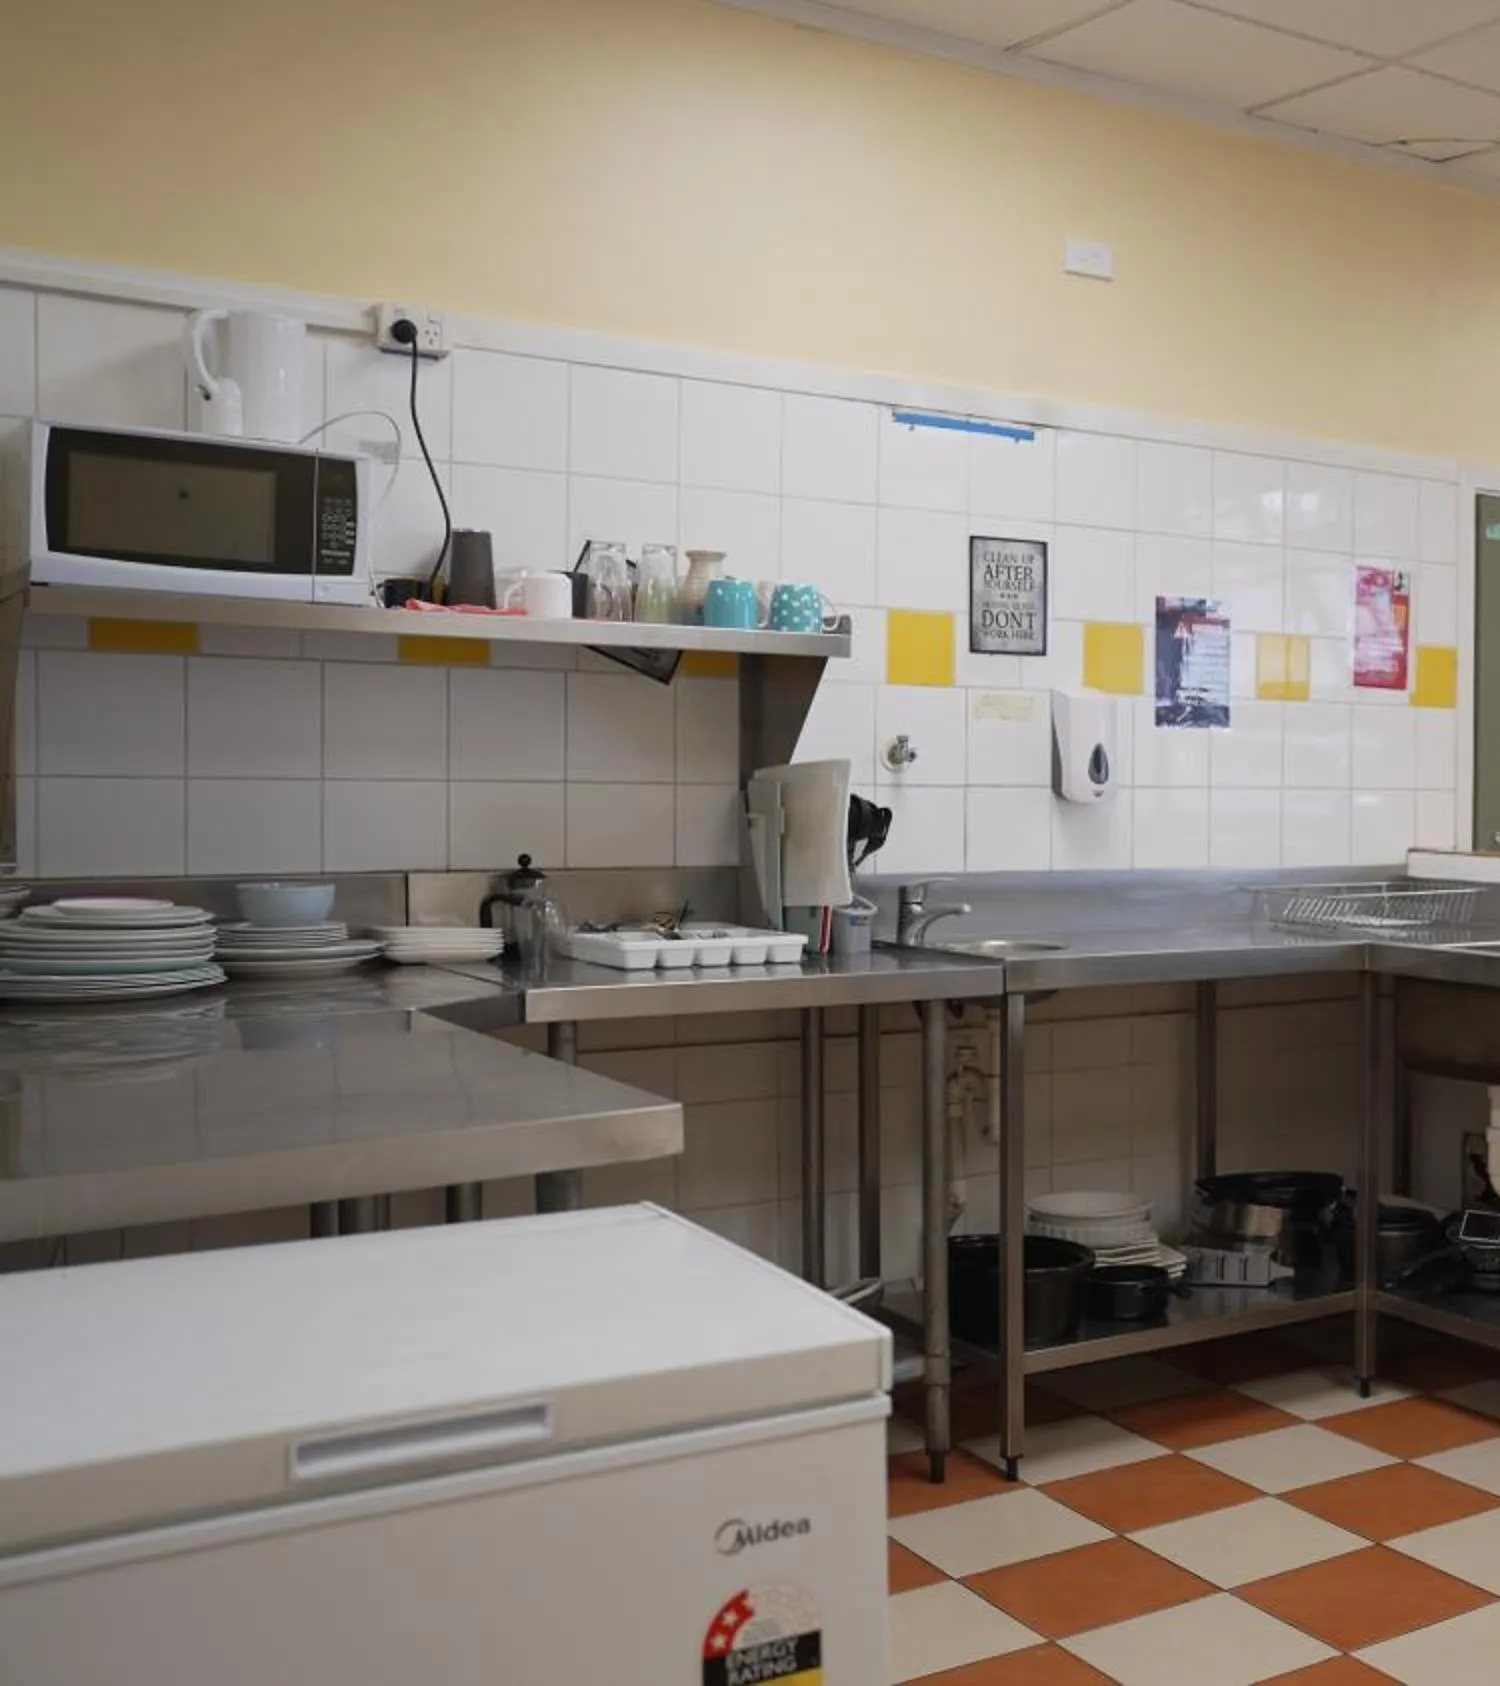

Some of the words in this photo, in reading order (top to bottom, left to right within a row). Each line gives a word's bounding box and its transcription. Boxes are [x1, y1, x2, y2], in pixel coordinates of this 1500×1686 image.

[983, 551, 1018, 563] CLEAN
[984, 564, 1033, 580] AFTER
[714, 1517, 812, 1556] Midea
